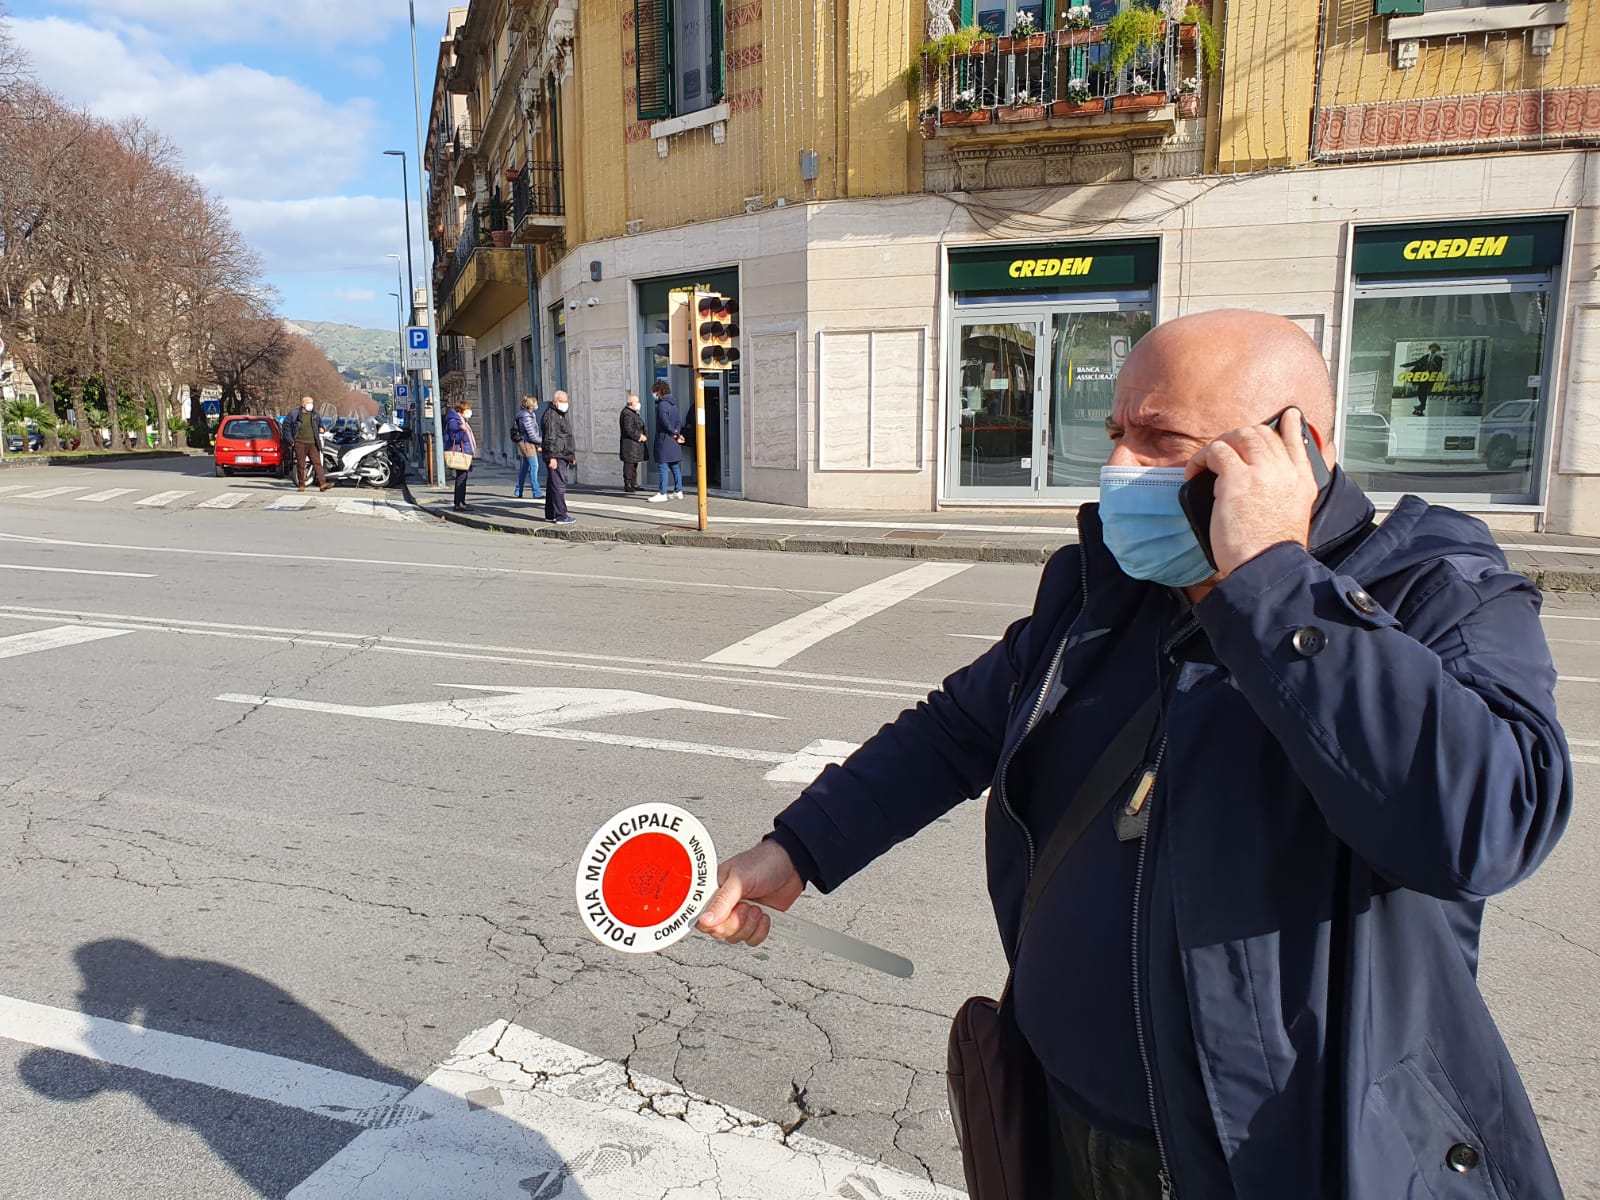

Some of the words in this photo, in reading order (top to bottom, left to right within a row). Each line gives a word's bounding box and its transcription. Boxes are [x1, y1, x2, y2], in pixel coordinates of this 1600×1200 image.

[1403, 236, 1509, 261] CREDEM
[1008, 256, 1094, 278] CREDEM
[413, 331, 424, 347] P
[1397, 372, 1449, 382] CREDEM
[398, 387, 406, 396] P
[585, 813, 683, 881] MUNICIPALE
[688, 835, 708, 887] MESSINA
[692, 889, 704, 902] DI
[585, 889, 637, 947] POLIZIA
[654, 903, 697, 941] COMUNE
